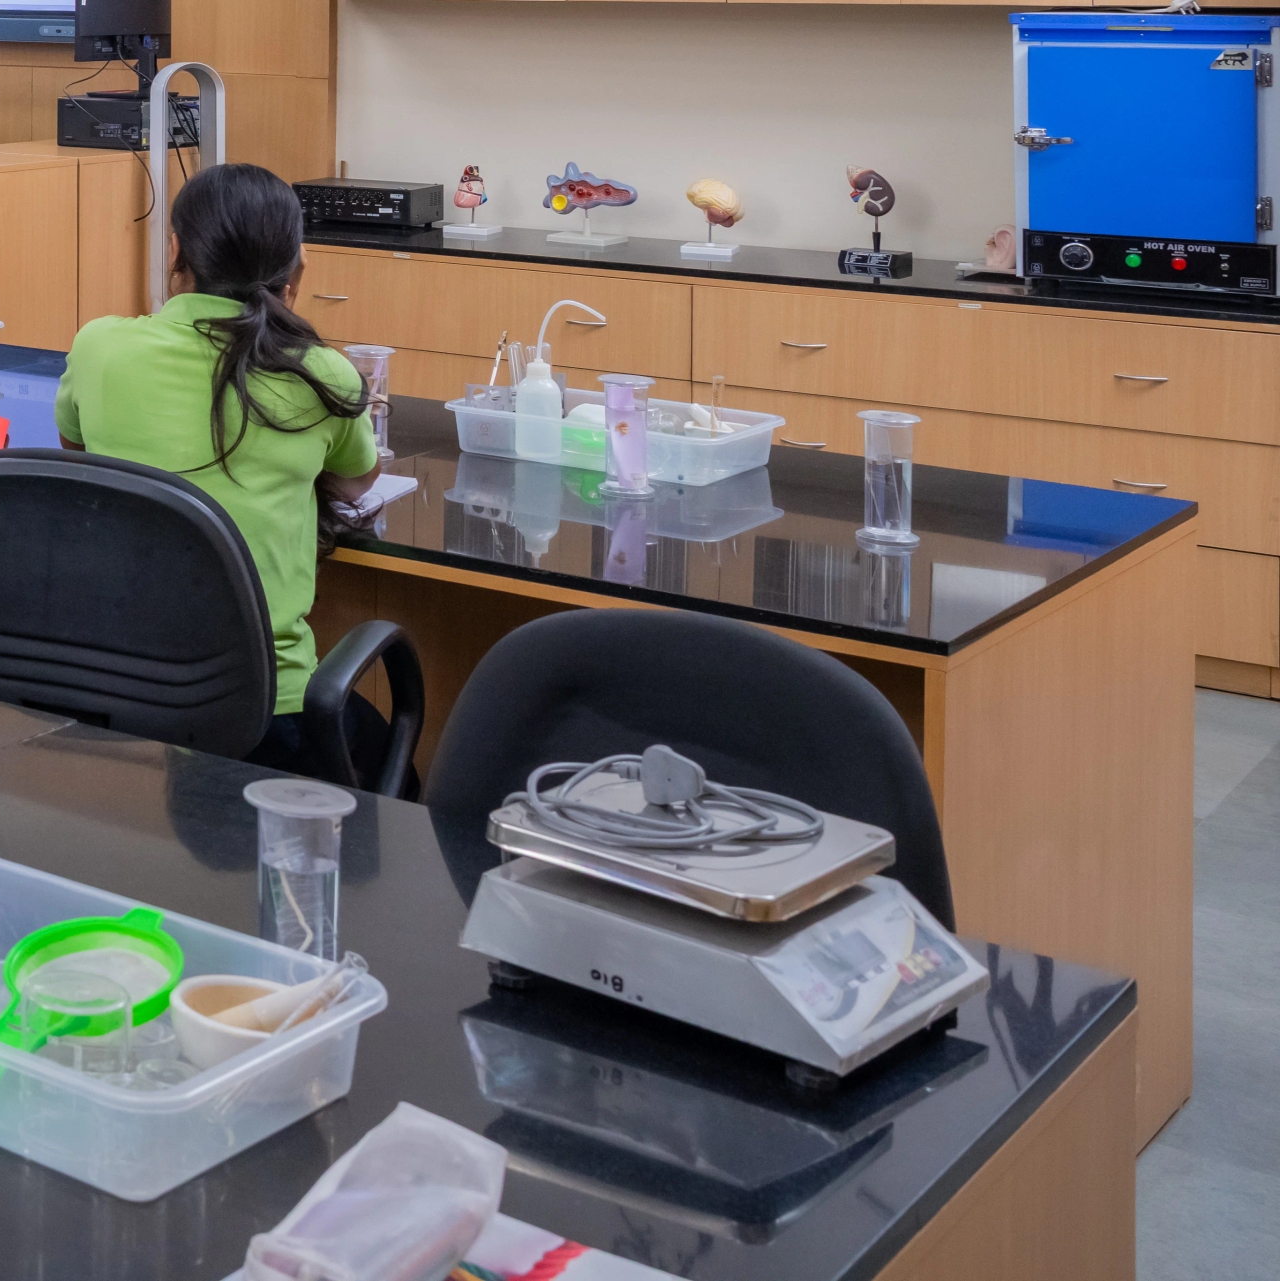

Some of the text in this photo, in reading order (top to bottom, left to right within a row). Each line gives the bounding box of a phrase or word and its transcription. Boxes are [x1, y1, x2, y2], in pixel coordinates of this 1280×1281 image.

[1144, 242, 1216, 253] HOT AIR OVEN
